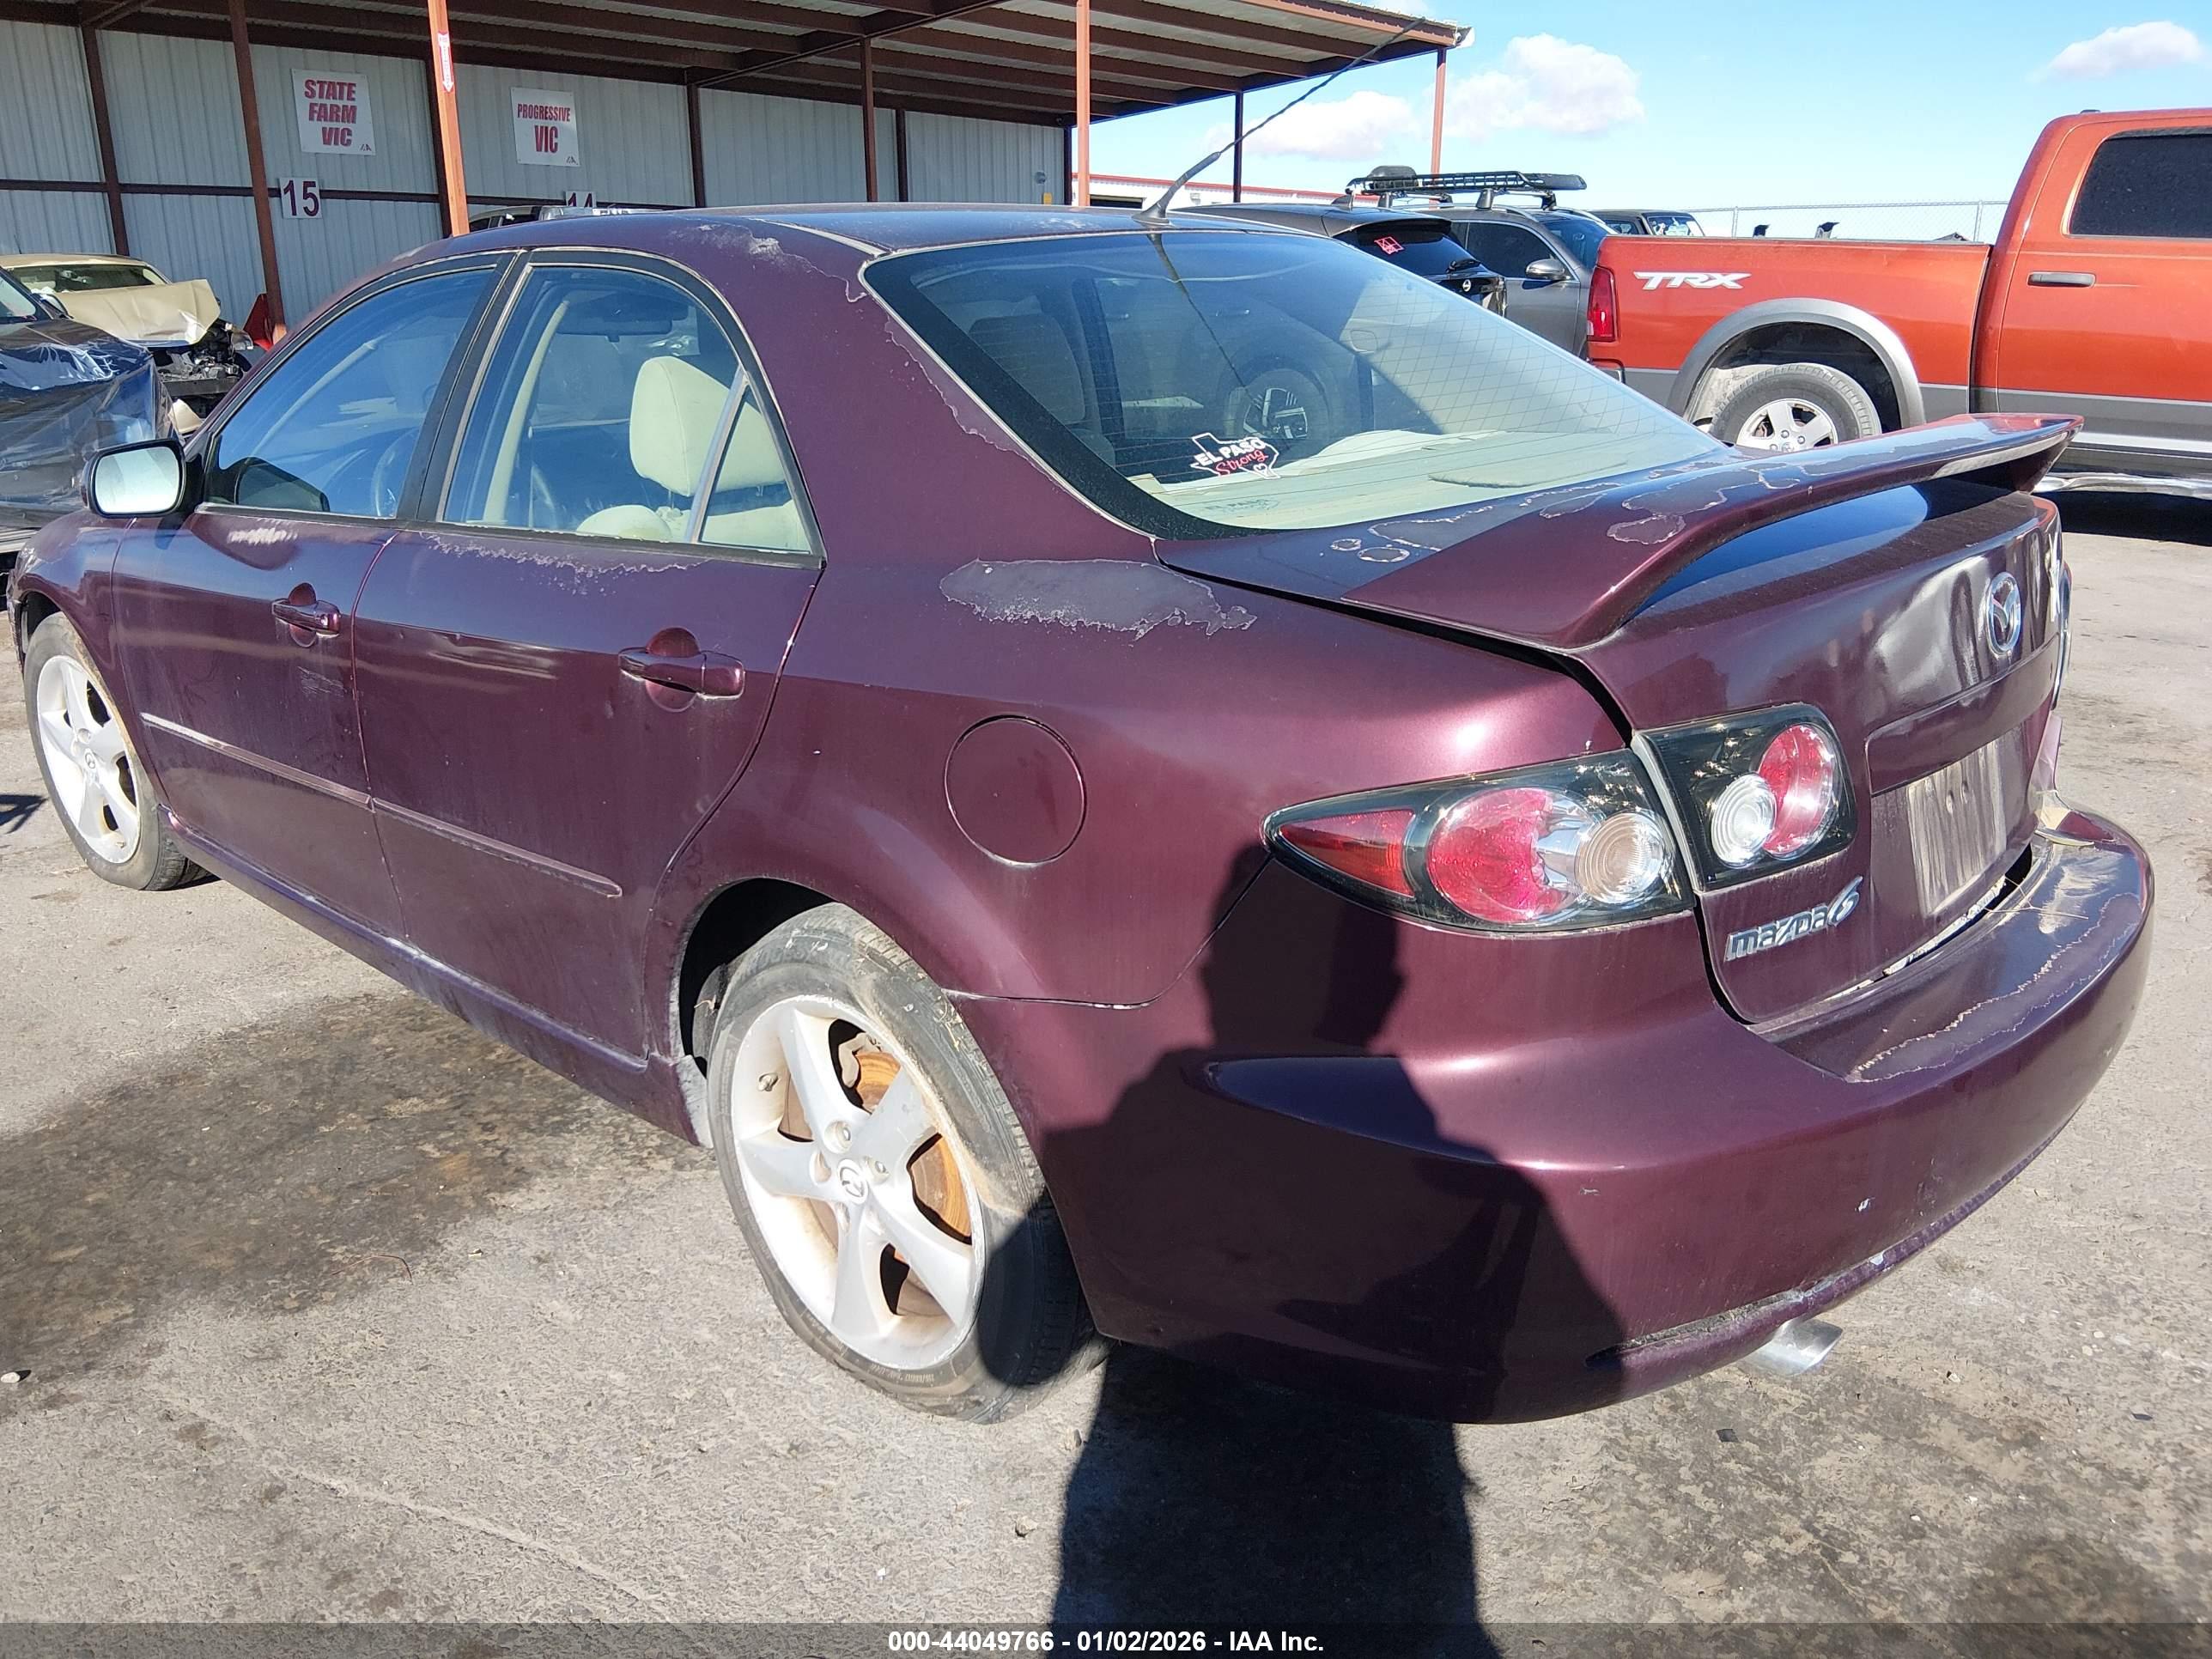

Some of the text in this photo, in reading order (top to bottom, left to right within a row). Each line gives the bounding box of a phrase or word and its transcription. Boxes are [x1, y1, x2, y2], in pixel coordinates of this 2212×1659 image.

[304, 79, 356, 101] STATE
[308, 102, 357, 125] FARM
[517, 103, 571, 122] PROGRESSIVE
[321, 126, 353, 147] VIC
[534, 125, 559, 154] VIC
[283, 179, 319, 216] 15
[1632, 270, 1753, 290] TRX
[1194, 439, 1267, 466] EL PASO
[1216, 449, 1269, 477] Strong
